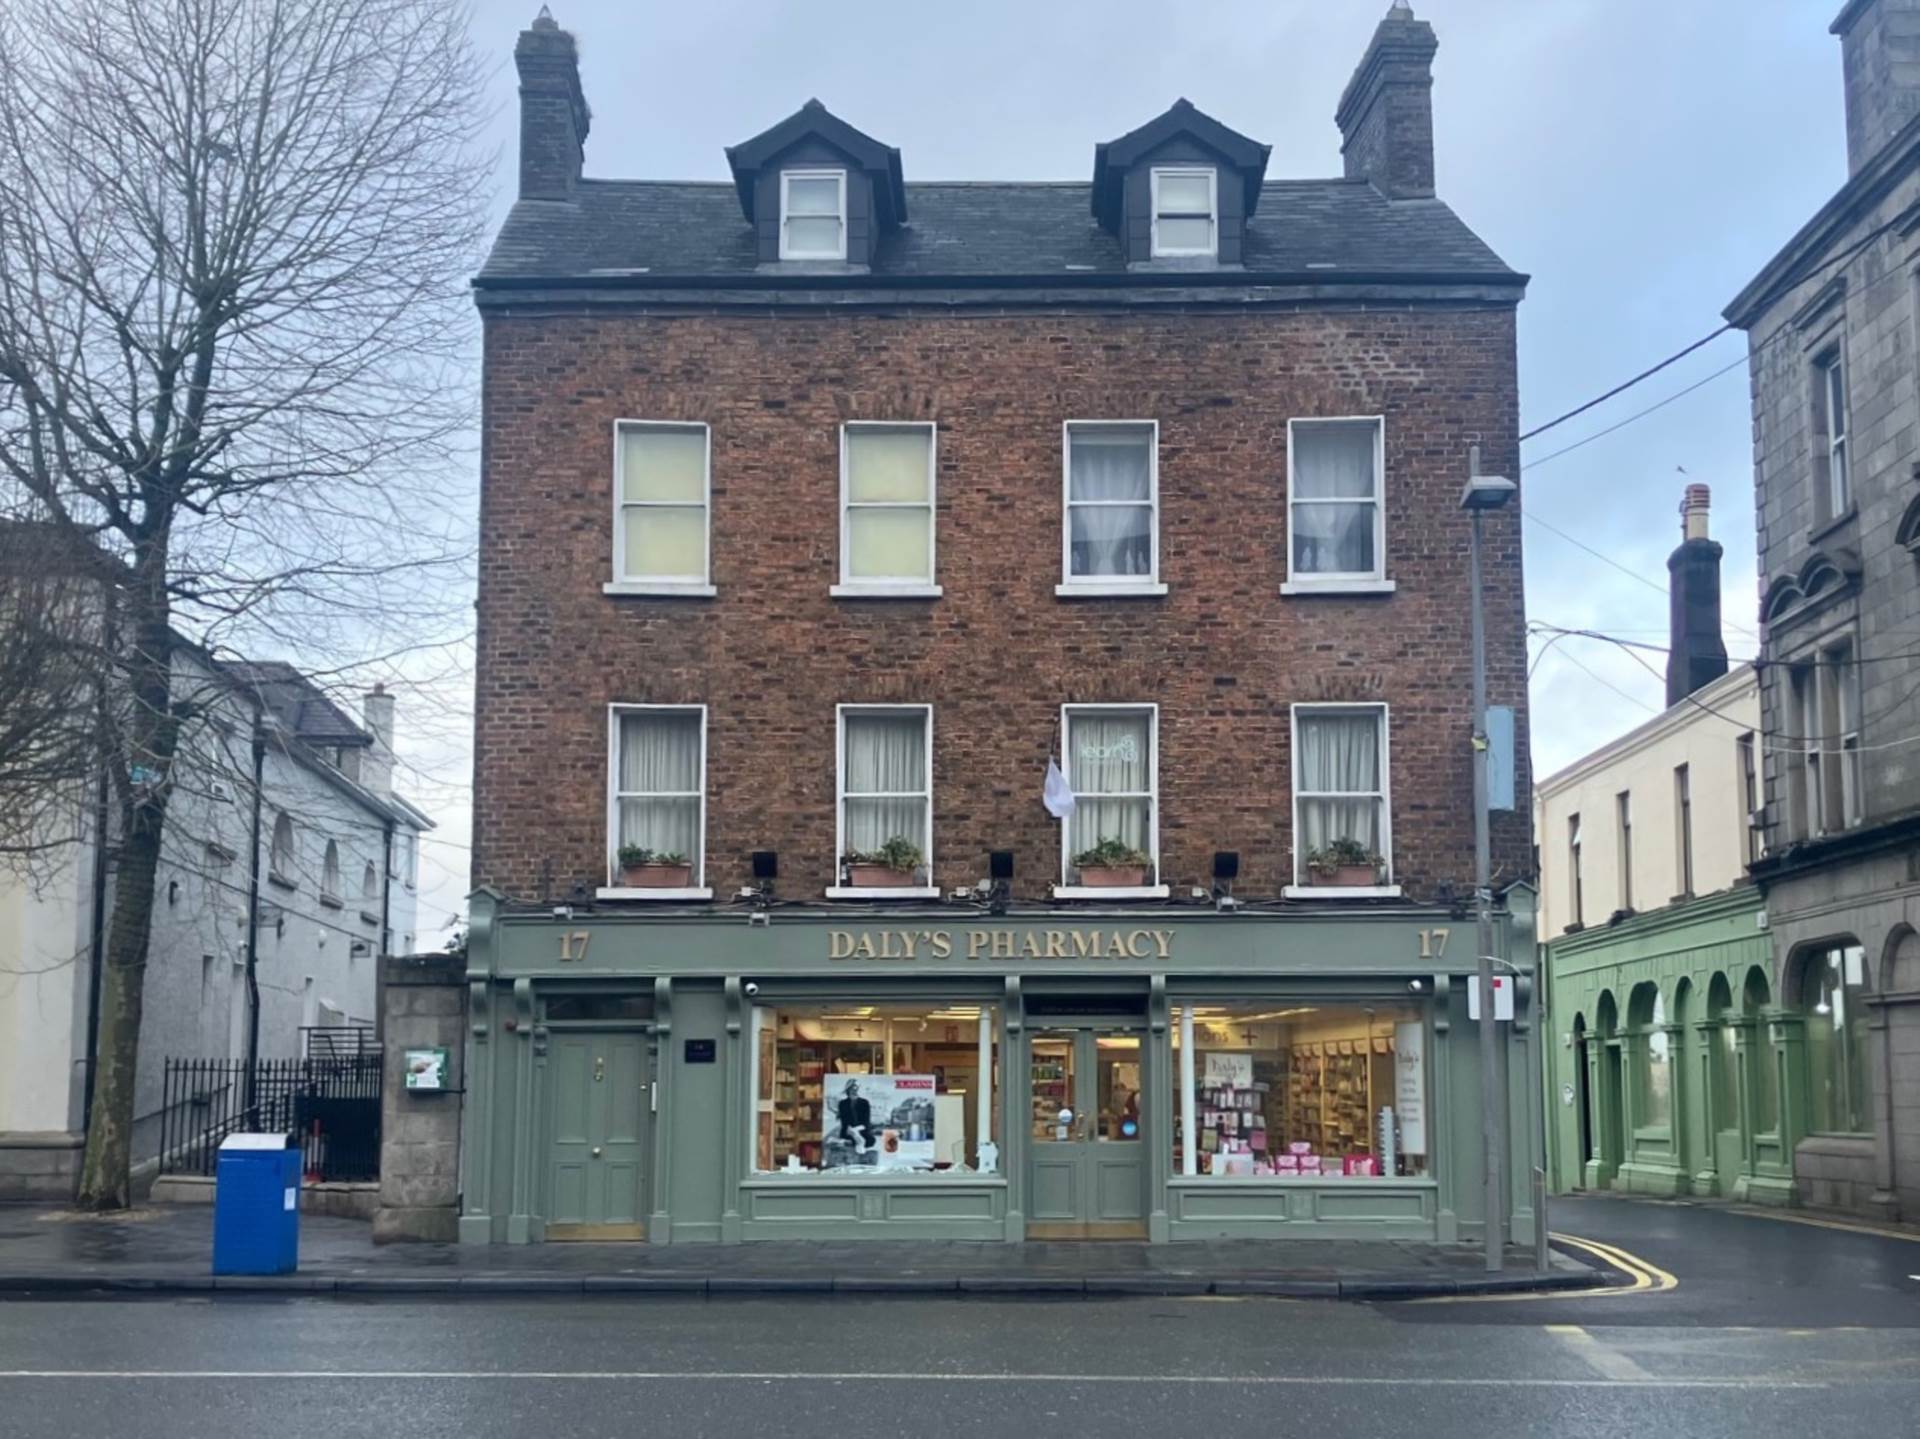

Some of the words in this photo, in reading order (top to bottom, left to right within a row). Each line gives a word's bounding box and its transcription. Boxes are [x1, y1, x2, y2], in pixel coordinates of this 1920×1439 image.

[559, 930, 591, 961] 17
[829, 930, 953, 960] DALY'S
[967, 929, 1176, 960] PHARMACY
[1418, 928, 1450, 959] 17
